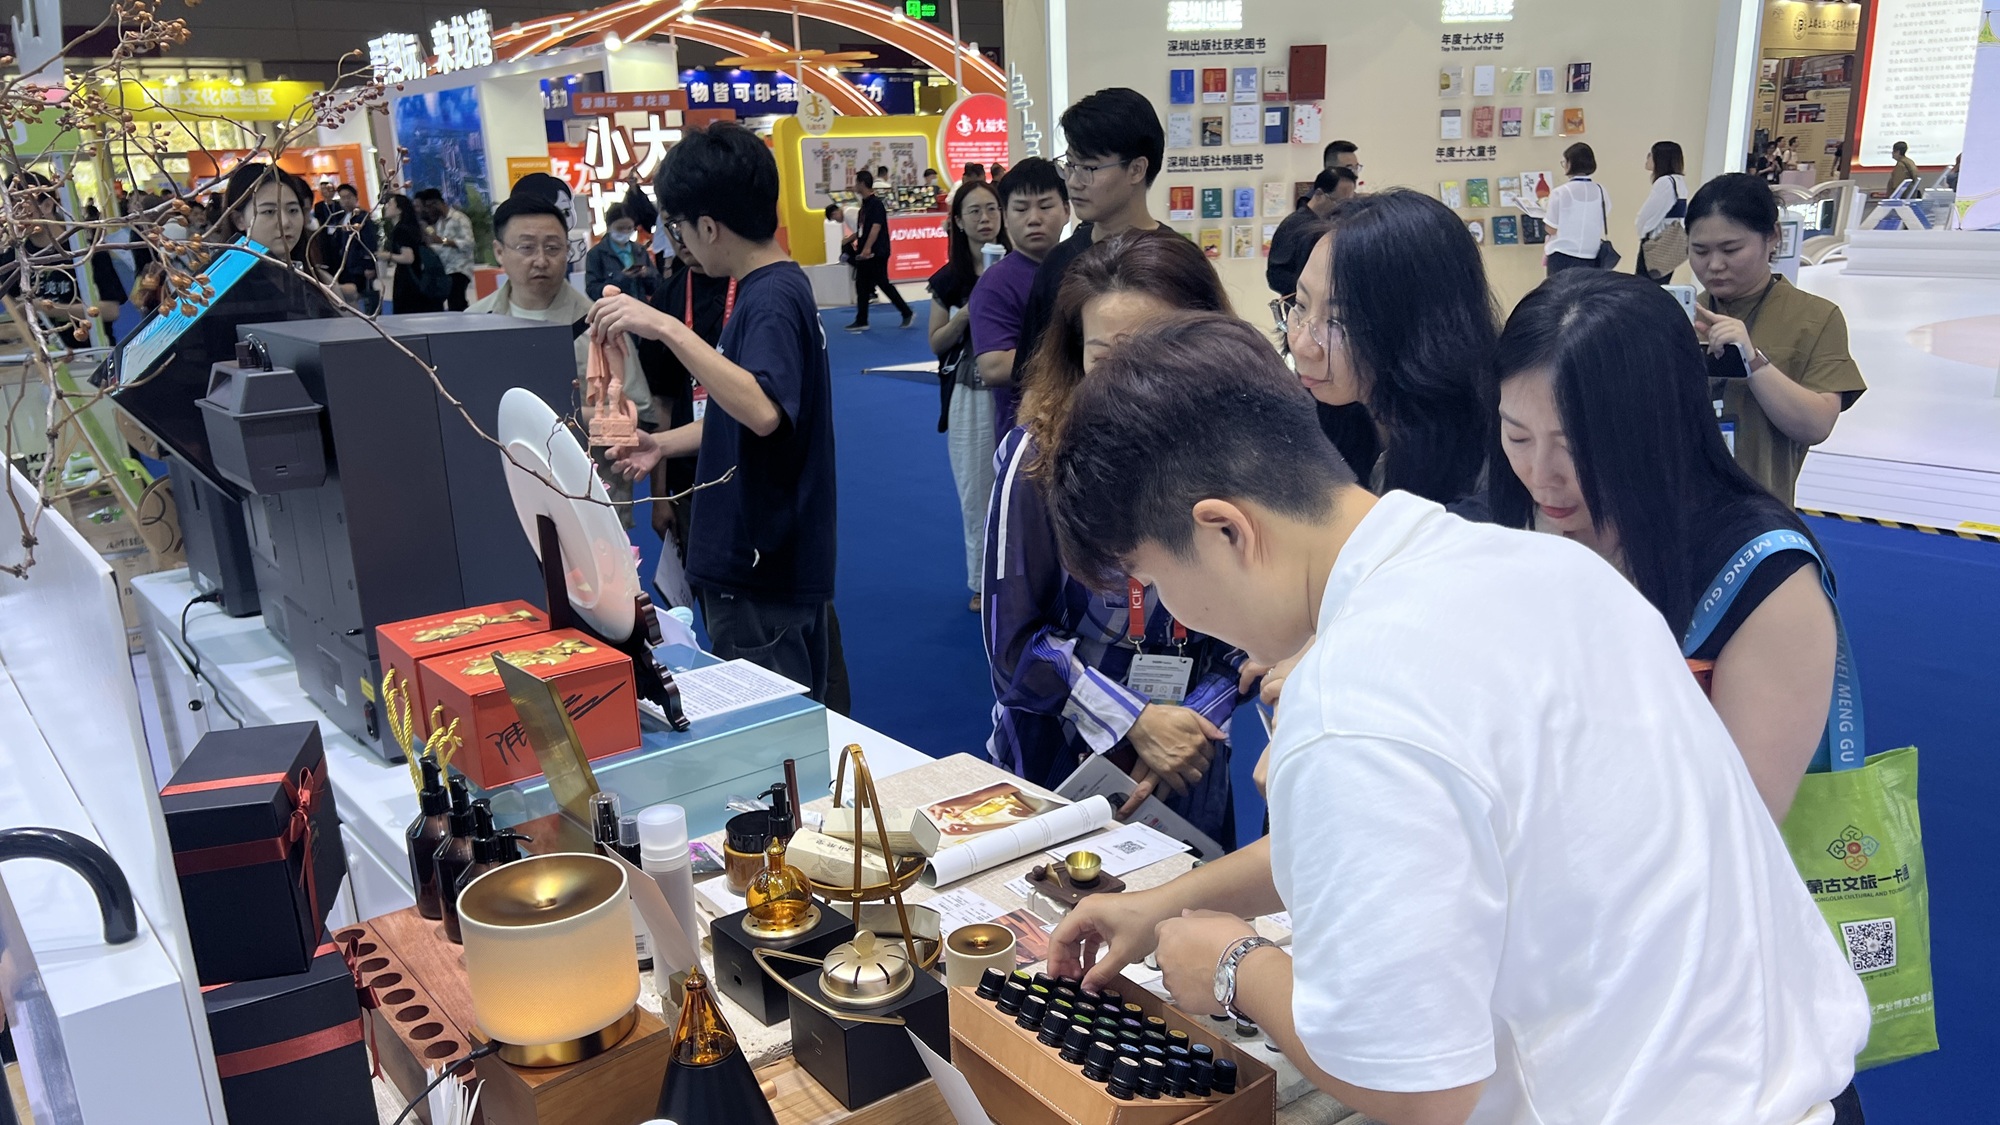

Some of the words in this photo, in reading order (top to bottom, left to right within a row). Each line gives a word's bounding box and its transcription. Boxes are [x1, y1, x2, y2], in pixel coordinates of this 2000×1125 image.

[1168, 38, 1266, 51] 深圳出版社获奖图书
[1441, 32, 1504, 45] 年度十大好书
[1167, 153, 1263, 168] 深圳出版社畅销图书
[1723, 538, 1773, 585] MENG
[1132, 587, 1142, 609] ICIF
[1703, 587, 1723, 612] GU
[1836, 651, 1850, 679] NEI
[1838, 683, 1854, 732] MENG
[1840, 738, 1855, 762] GU
[1815, 895, 1844, 903] ONGOLIA
